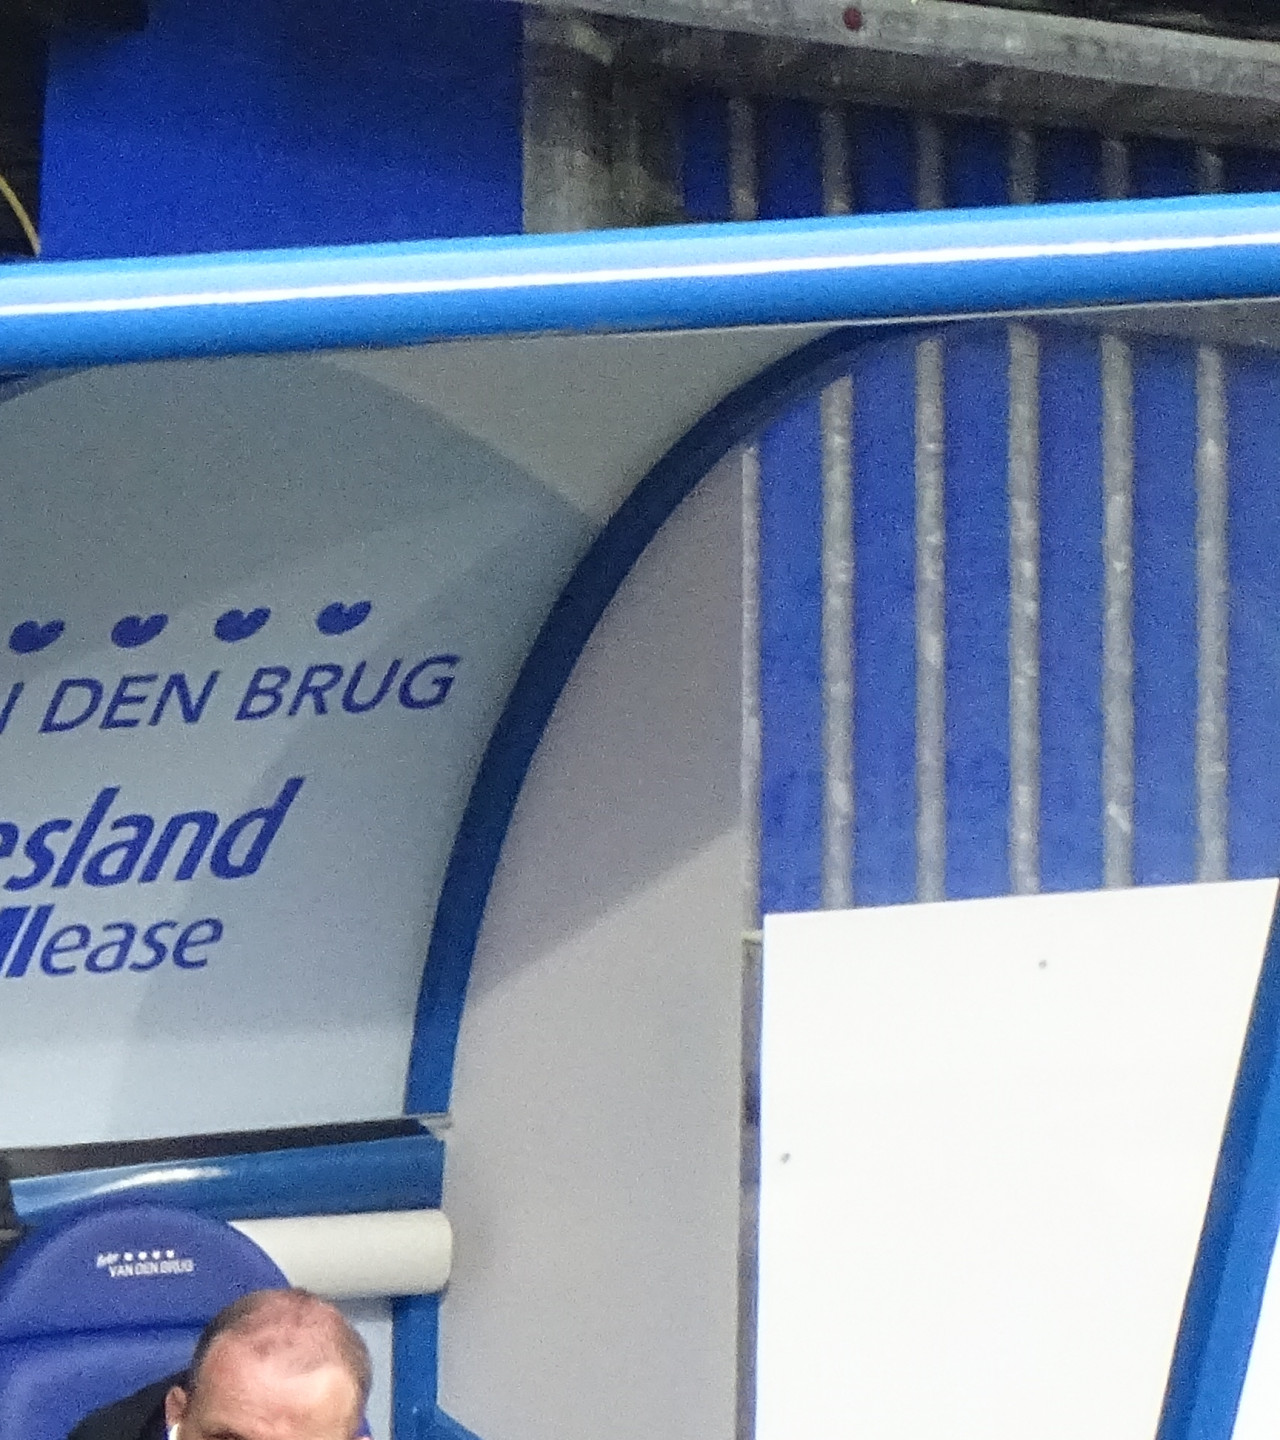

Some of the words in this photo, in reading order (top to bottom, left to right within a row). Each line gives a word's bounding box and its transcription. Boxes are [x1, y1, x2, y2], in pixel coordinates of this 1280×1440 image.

[39, 670, 221, 734] DEN
[235, 653, 461, 721] BRUG
[6, 903, 224, 978] lease
